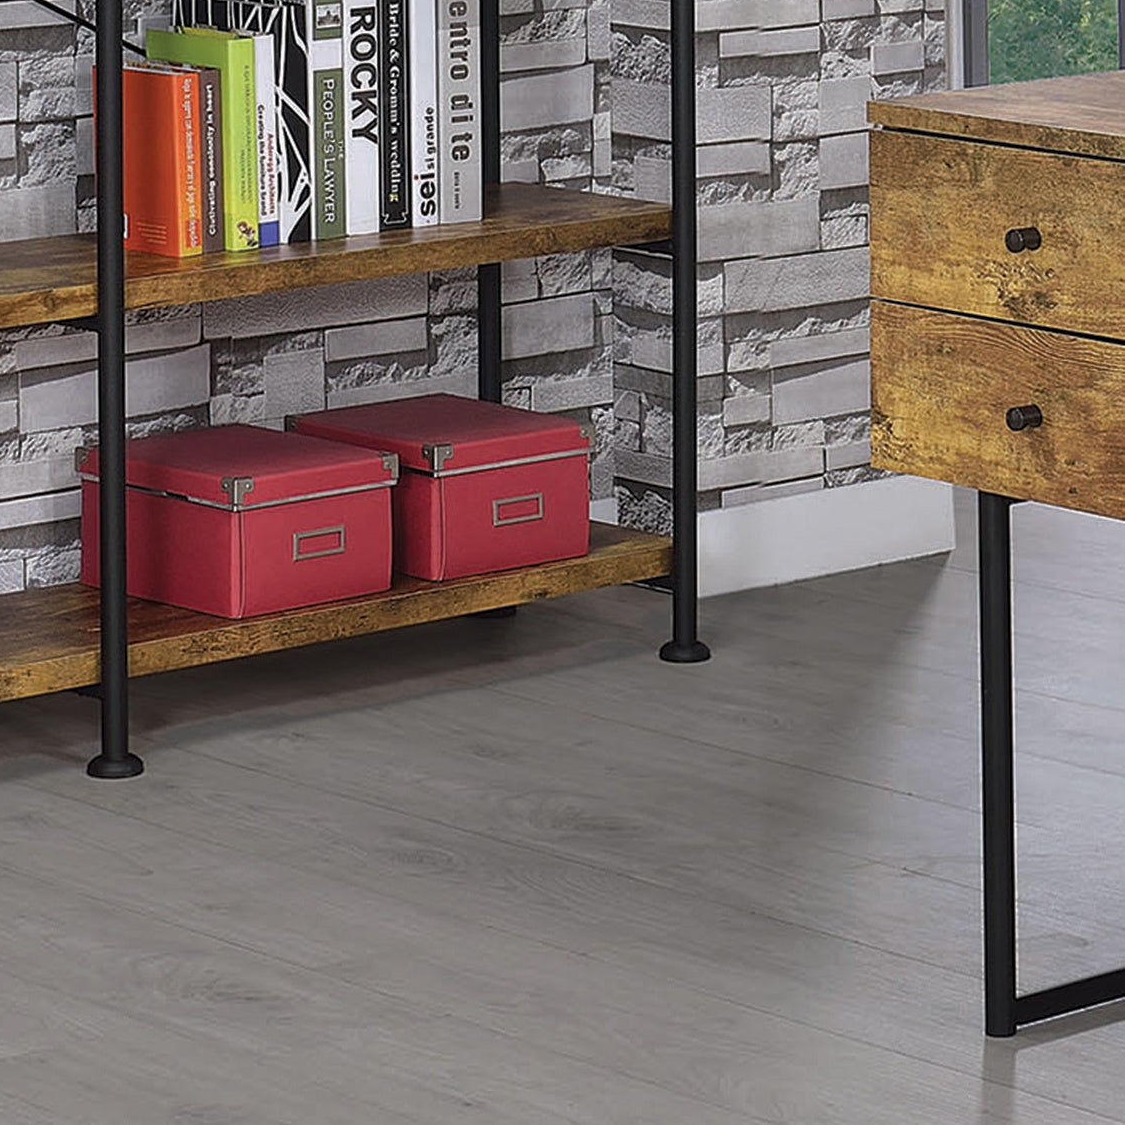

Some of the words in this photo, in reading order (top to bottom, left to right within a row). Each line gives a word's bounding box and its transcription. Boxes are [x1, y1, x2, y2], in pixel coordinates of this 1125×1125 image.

[388, 2, 399, 46] Bride
[349, 5, 379, 145] ROCKY
[389, 48, 399, 64] &
[257, 104, 265, 140] Creating
[322, 78, 336, 155] PEOPLE'S
[425, 107, 437, 154] grande
[449, 94, 473, 123] di
[425, 155, 435, 170] si
[451, 132, 474, 162] te
[324, 157, 337, 224] LAWYER
[389, 140, 401, 203] wedding
[414, 173, 436, 217] sei
